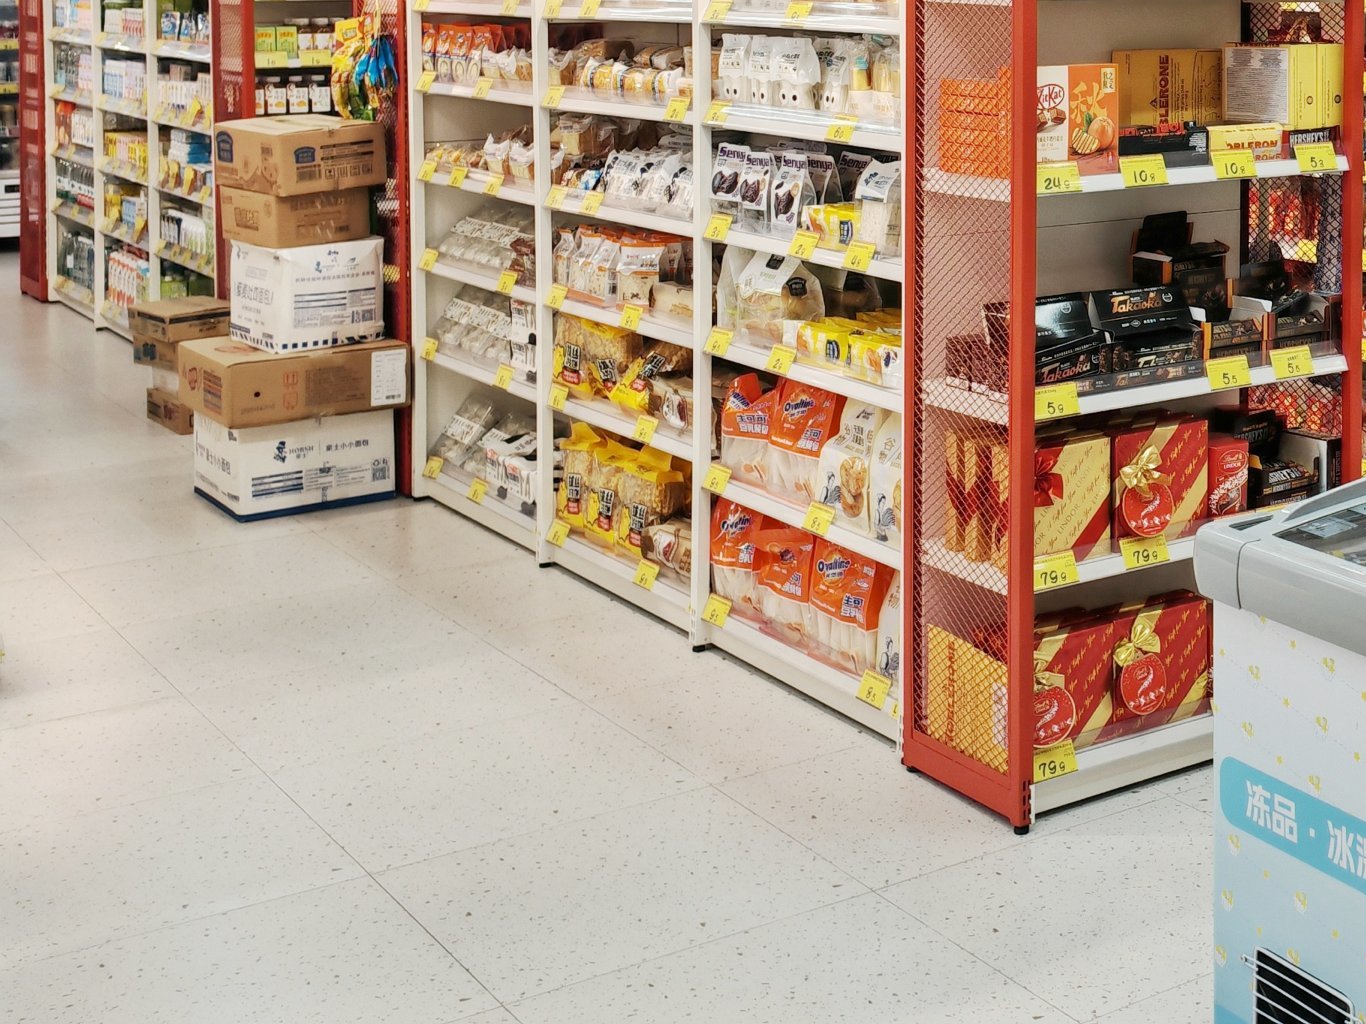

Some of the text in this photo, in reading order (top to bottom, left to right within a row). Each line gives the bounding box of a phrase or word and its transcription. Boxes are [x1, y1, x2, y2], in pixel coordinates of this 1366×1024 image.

[1070, 82, 1108, 124] 秋
[1110, 291, 1162, 314] Takaoka
[1041, 353, 1091, 385] Takaoka
[784, 397, 816, 413] Ovaltine
[818, 557, 850, 573] Ovaltine
